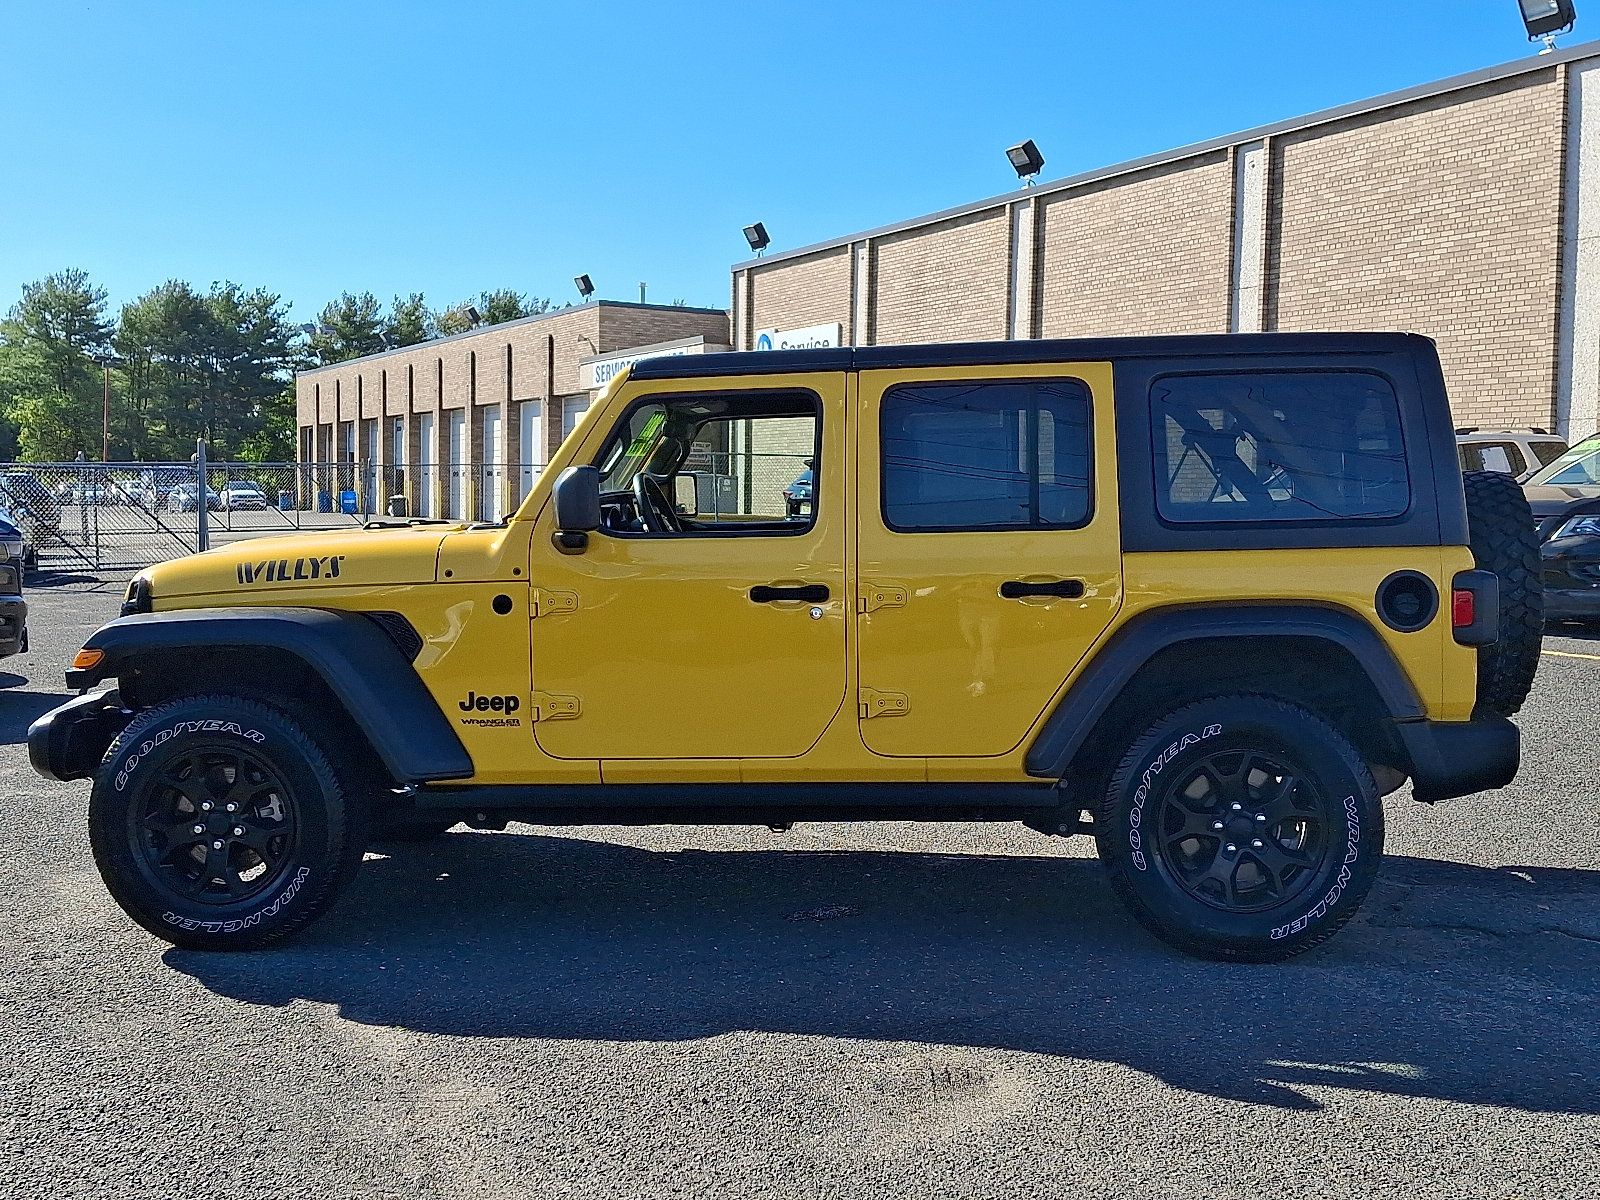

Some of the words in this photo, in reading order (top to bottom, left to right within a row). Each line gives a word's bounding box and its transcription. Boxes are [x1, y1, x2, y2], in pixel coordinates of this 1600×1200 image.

[595, 360, 631, 383] SERVI
[236, 555, 345, 584] WILLYS
[458, 691, 520, 715] Jeep
[115, 719, 266, 792] GOODYEAR
[1129, 723, 1222, 871] GOODYEAR
[162, 866, 310, 933] WRANGLER
[1270, 795, 1360, 940] WRANGLER
